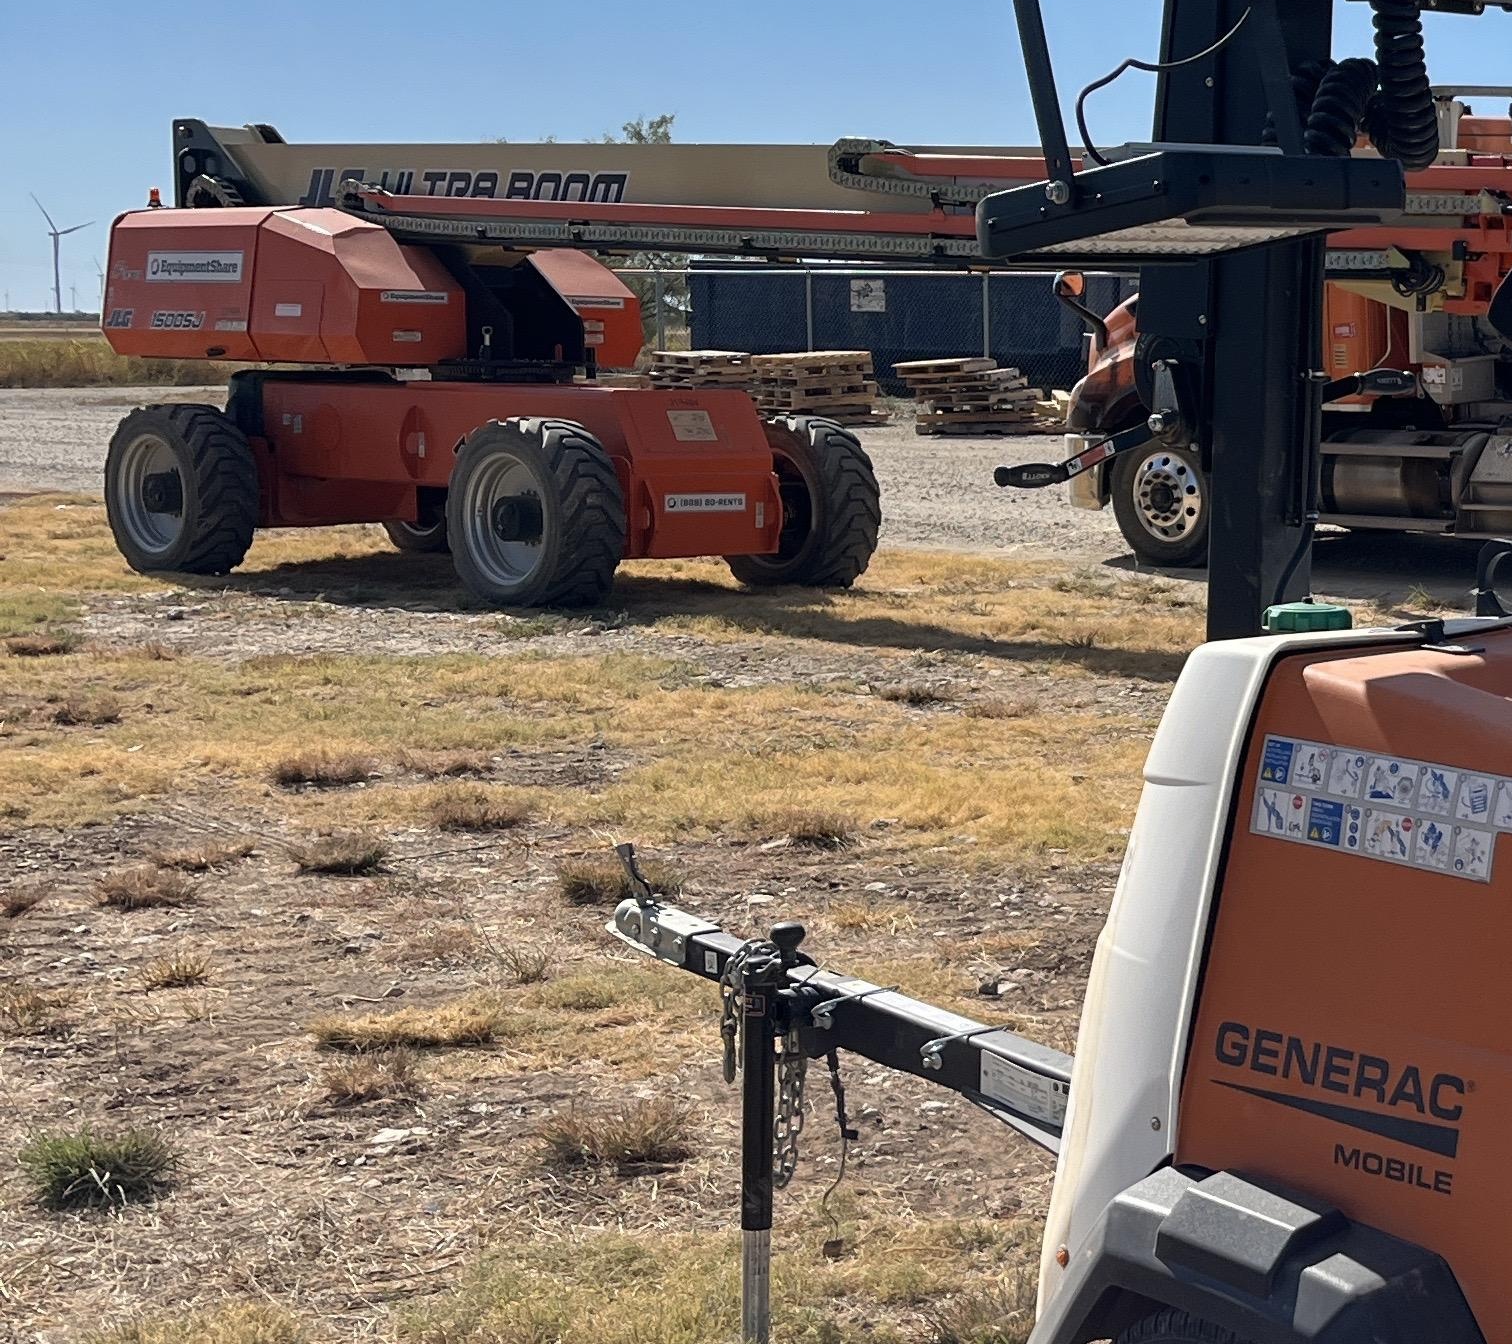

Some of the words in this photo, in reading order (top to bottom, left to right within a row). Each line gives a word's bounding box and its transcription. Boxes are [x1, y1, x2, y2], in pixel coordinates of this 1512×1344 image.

[505, 172, 628, 202] BOOM
[161, 259, 238, 276] EquipmentShare
[107, 309, 133, 327] JLG
[1214, 1020, 1465, 1121] GENERAC
[1333, 1143, 1453, 1195] MOBILE
